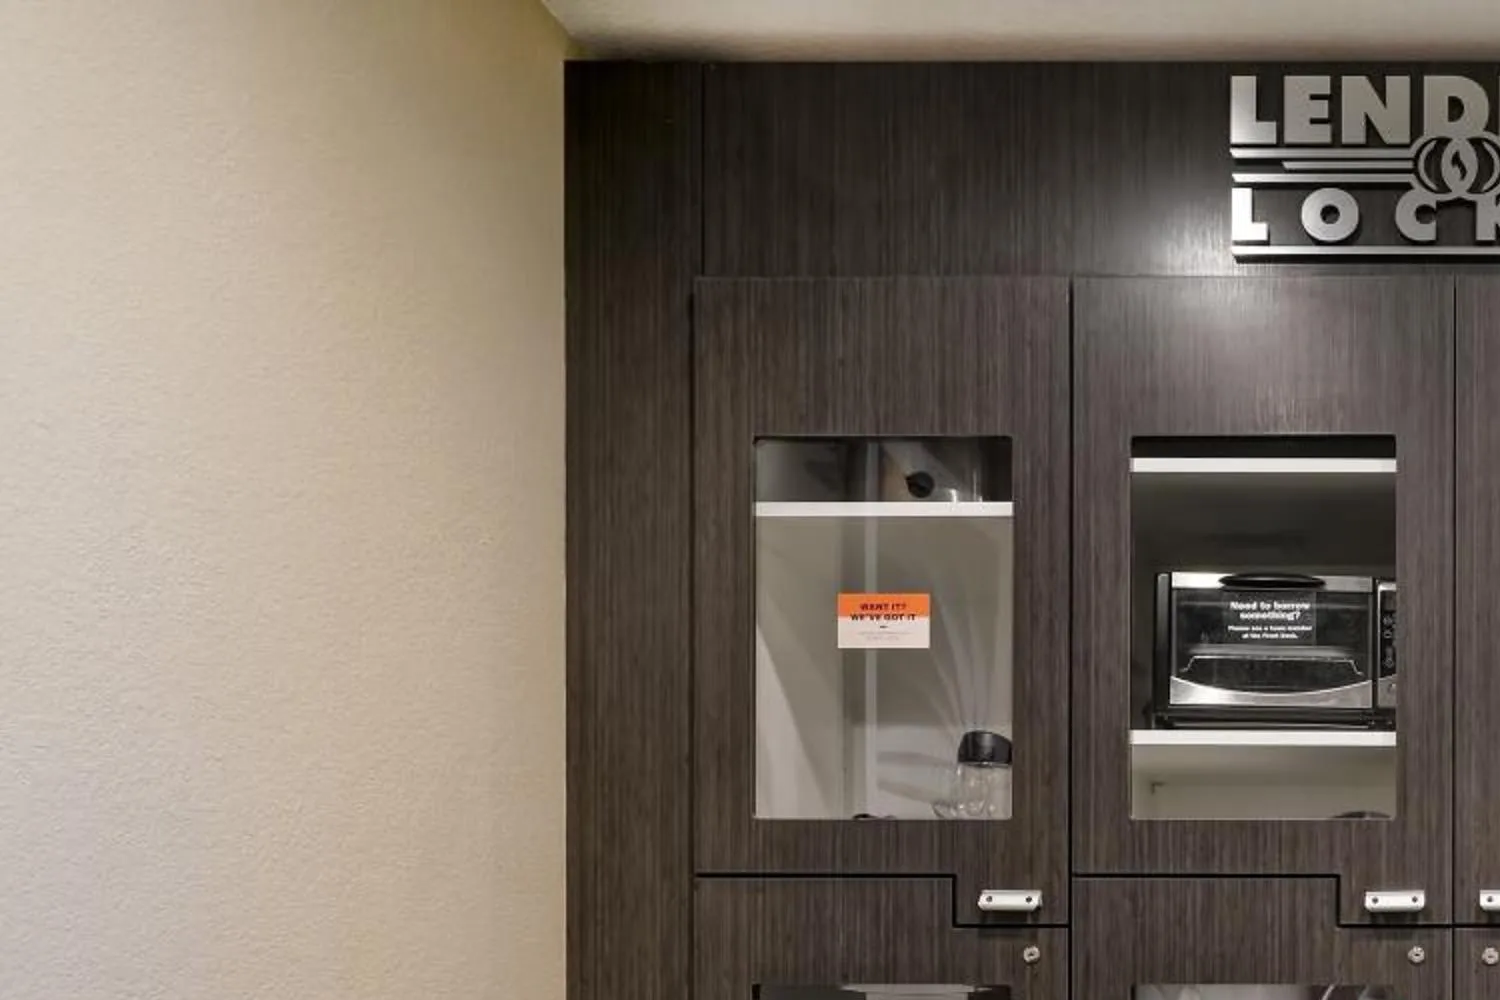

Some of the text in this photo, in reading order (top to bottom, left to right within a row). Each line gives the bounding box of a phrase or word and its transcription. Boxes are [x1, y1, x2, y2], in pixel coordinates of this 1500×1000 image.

[1229, 601, 1311, 610] Need to borrow
[1239, 611, 1301, 621] something?
